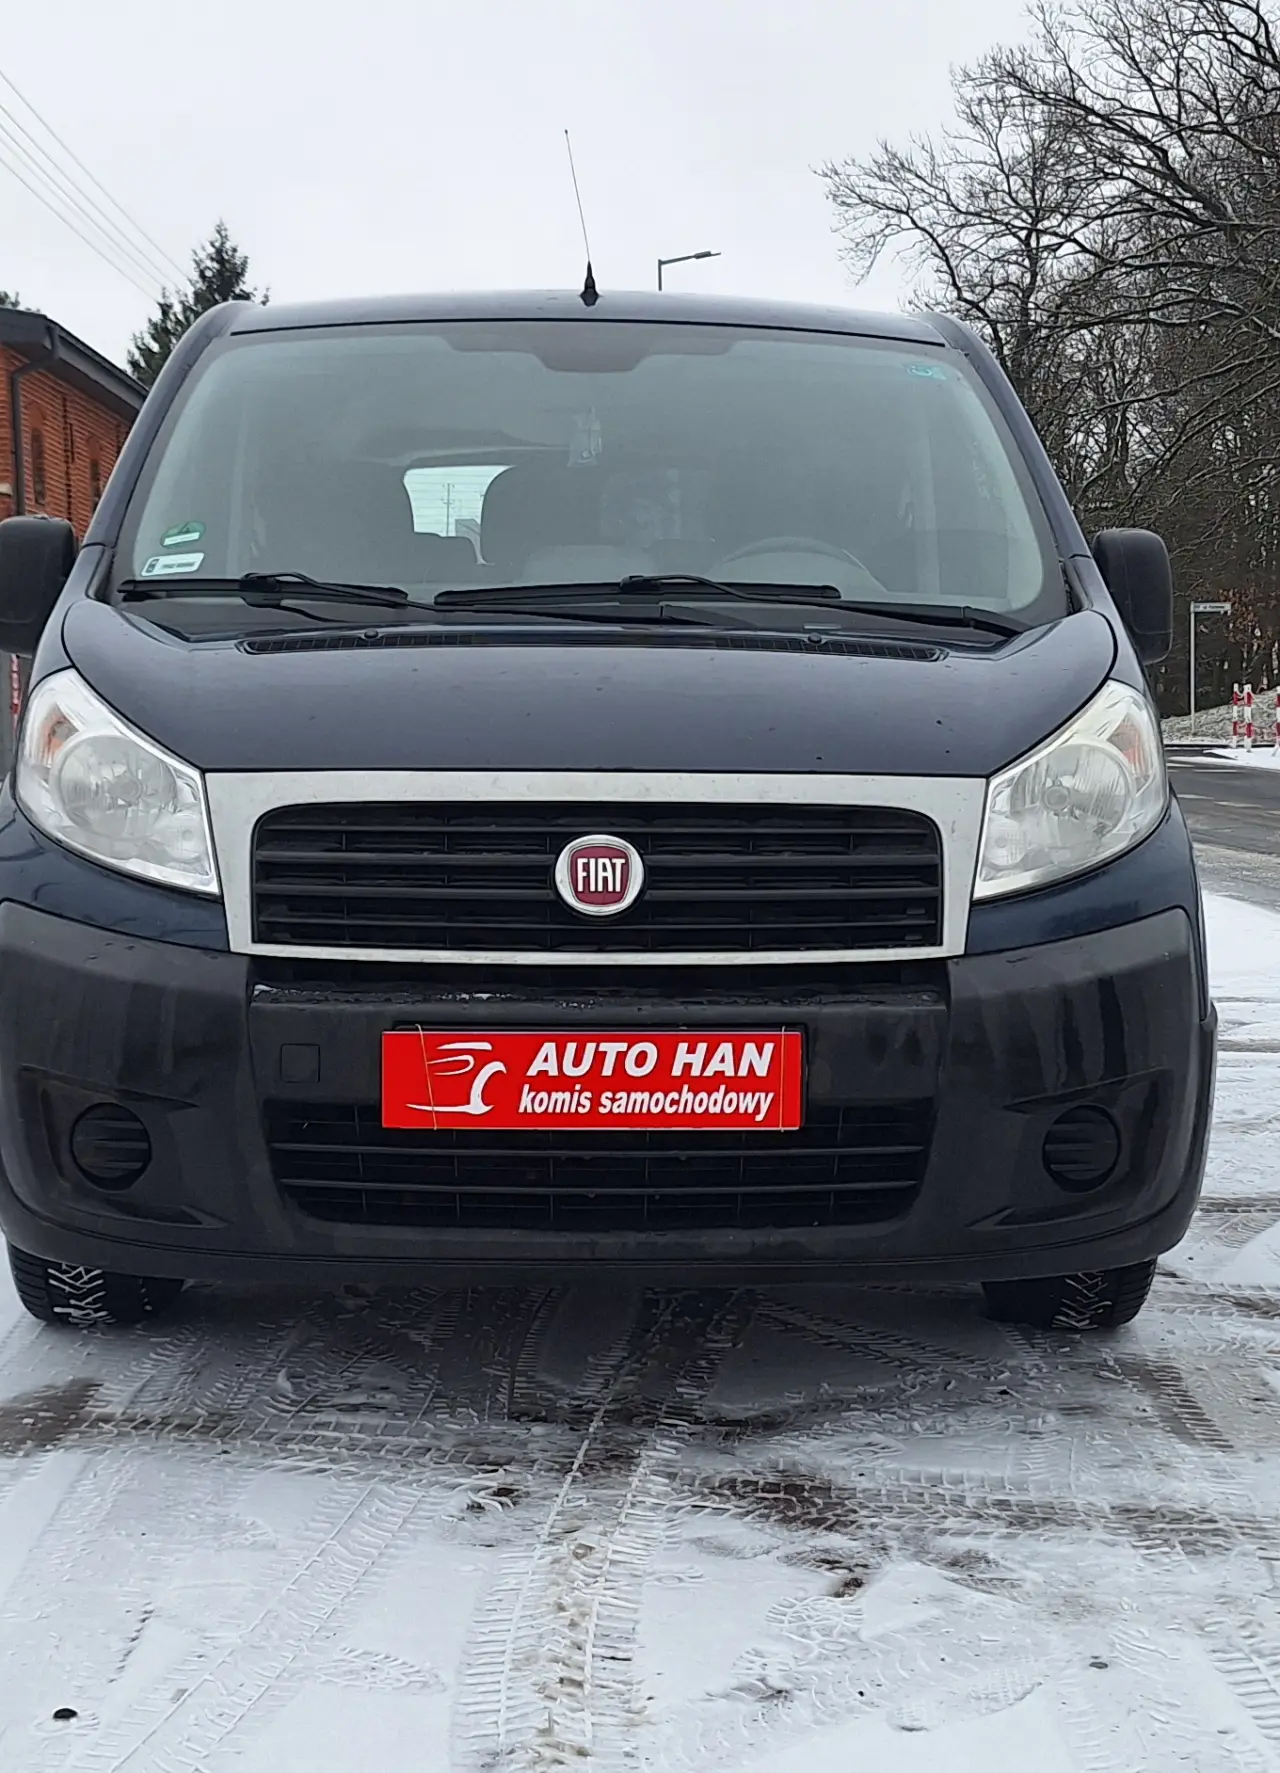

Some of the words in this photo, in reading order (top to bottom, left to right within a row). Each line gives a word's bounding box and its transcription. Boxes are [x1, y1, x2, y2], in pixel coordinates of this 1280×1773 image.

[577, 858, 625, 892] FIAT
[526, 1042, 658, 1077] AUTO
[671, 1042, 774, 1077] HAN
[519, 1084, 592, 1114] komis
[598, 1084, 774, 1121] samochodowy
